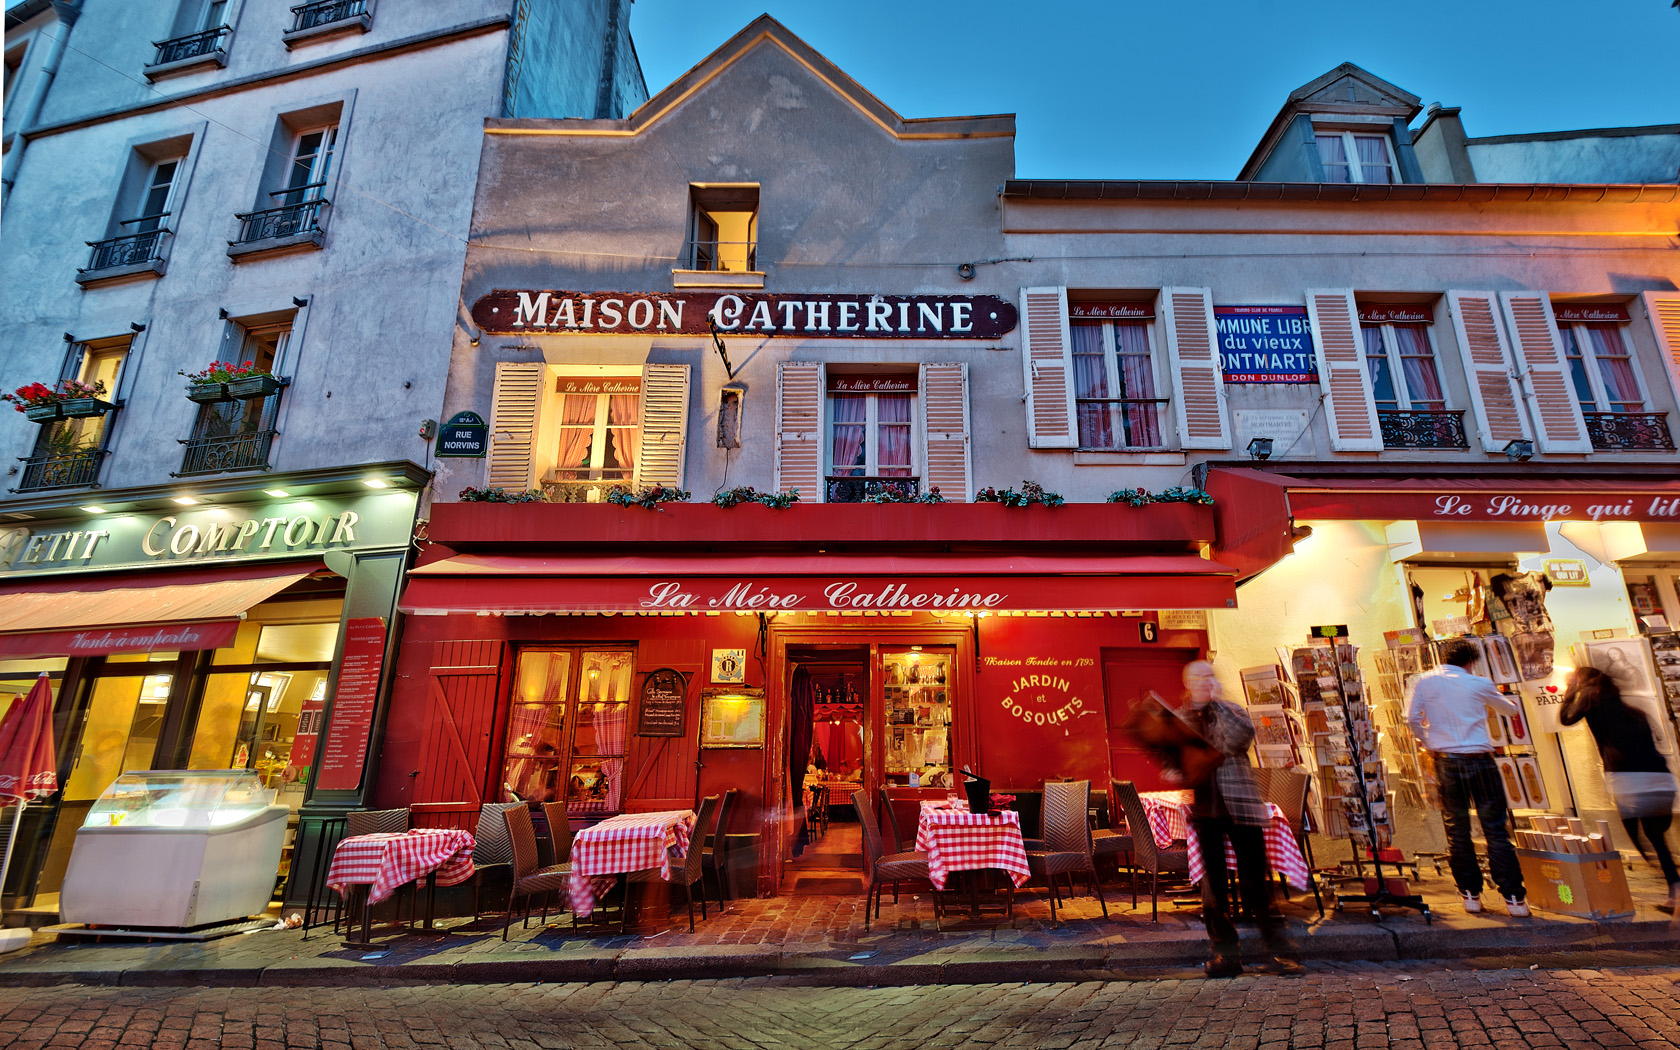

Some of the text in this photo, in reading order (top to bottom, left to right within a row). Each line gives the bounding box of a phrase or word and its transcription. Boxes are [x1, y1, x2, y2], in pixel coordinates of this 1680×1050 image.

[513, 292, 974, 332] MAISON CATHERINE
[1073, 306, 1084, 316] La
[1109, 306, 1145, 316] Catherine
[1388, 310, 1425, 320] Catherine
[1581, 309, 1619, 319] Catherine
[1216, 319, 1312, 335] MMUNE LIBR
[1225, 334, 1303, 350] du vieux
[1219, 353, 1317, 370] ONTMARTR
[1231, 374, 1307, 382] DON DUNLOP
[565, 381, 639, 393] La Mère Catherine
[836, 380, 848, 390] La
[872, 379, 909, 390] Catherine
[455, 431, 472, 439] RUE
[444, 441, 480, 450] NORVINS
[1433, 495, 1472, 516] Le
[1486, 495, 1573, 521] Singe
[1586, 500, 1634, 521] qui
[0, 511, 359, 564] PETIT COMPTOIR
[641, 582, 700, 608] La
[824, 582, 1008, 608] Catherine
[1144, 623, 1154, 641] 6
[68, 632, 111, 649] Vente
[130, 627, 201, 652] emporter
[984, 656, 1022, 666] Maison
[1025, 657, 1058, 666] Fondée
[1074, 658, 1094, 668] 1793
[1012, 675, 1070, 693] JARDIN
[1538, 686, 1546, 695] I
[1036, 694, 1047, 703] et
[1535, 694, 1565, 706] PARI
[1001, 696, 1083, 726] BOSQUETS
